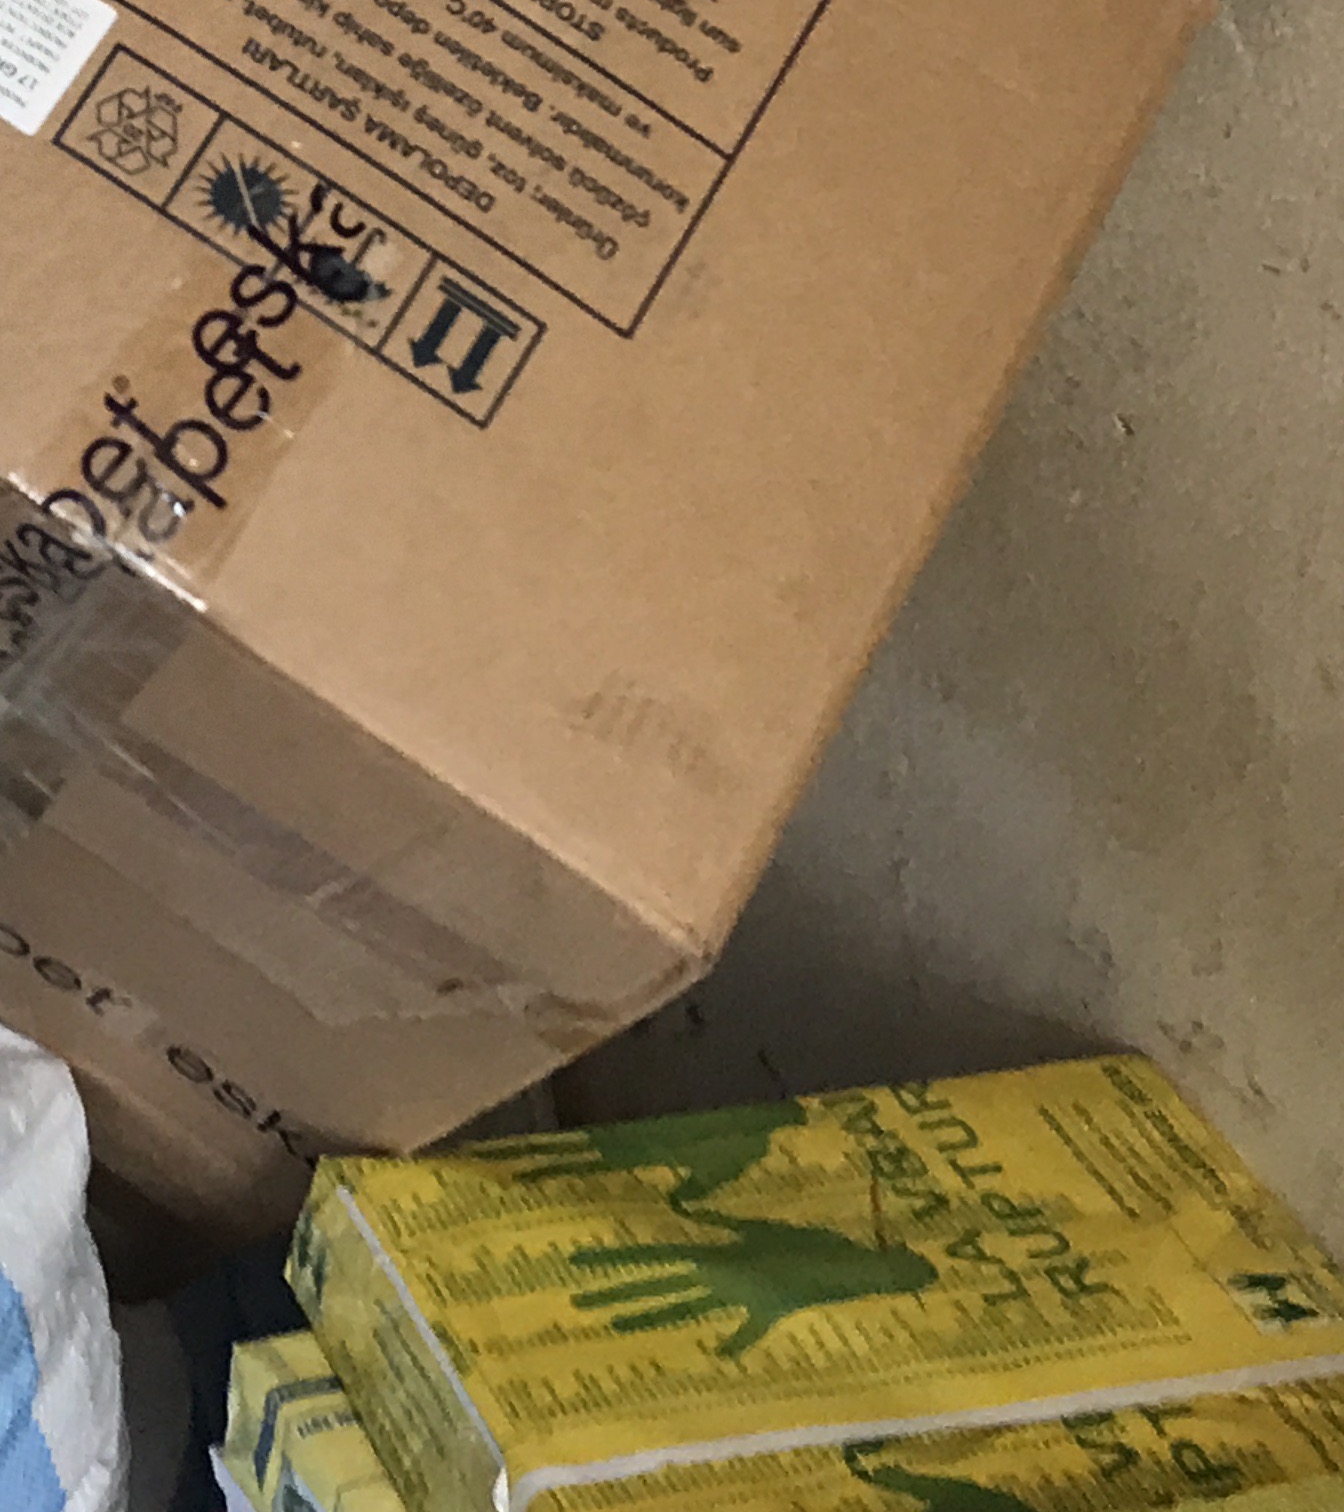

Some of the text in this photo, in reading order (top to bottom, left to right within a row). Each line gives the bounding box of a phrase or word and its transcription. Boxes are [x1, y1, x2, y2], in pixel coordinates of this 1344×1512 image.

[332, 11, 395, 57] sahip
[615, 7, 714, 83] Products
[698, 20, 742, 54] sun
[501, 30, 622, 117] maksimum
[242, 36, 496, 213] DEPOLAMA ŞARTLARI
[485, 110, 568, 172] solvent
[624, 114, 652, 139] ve
[487, 153, 527, 194] toz,
[164, 1041, 322, 1156] esk
[889, 1081, 1116, 1300] RUPTUR
[946, 1228, 1032, 1307] LA
